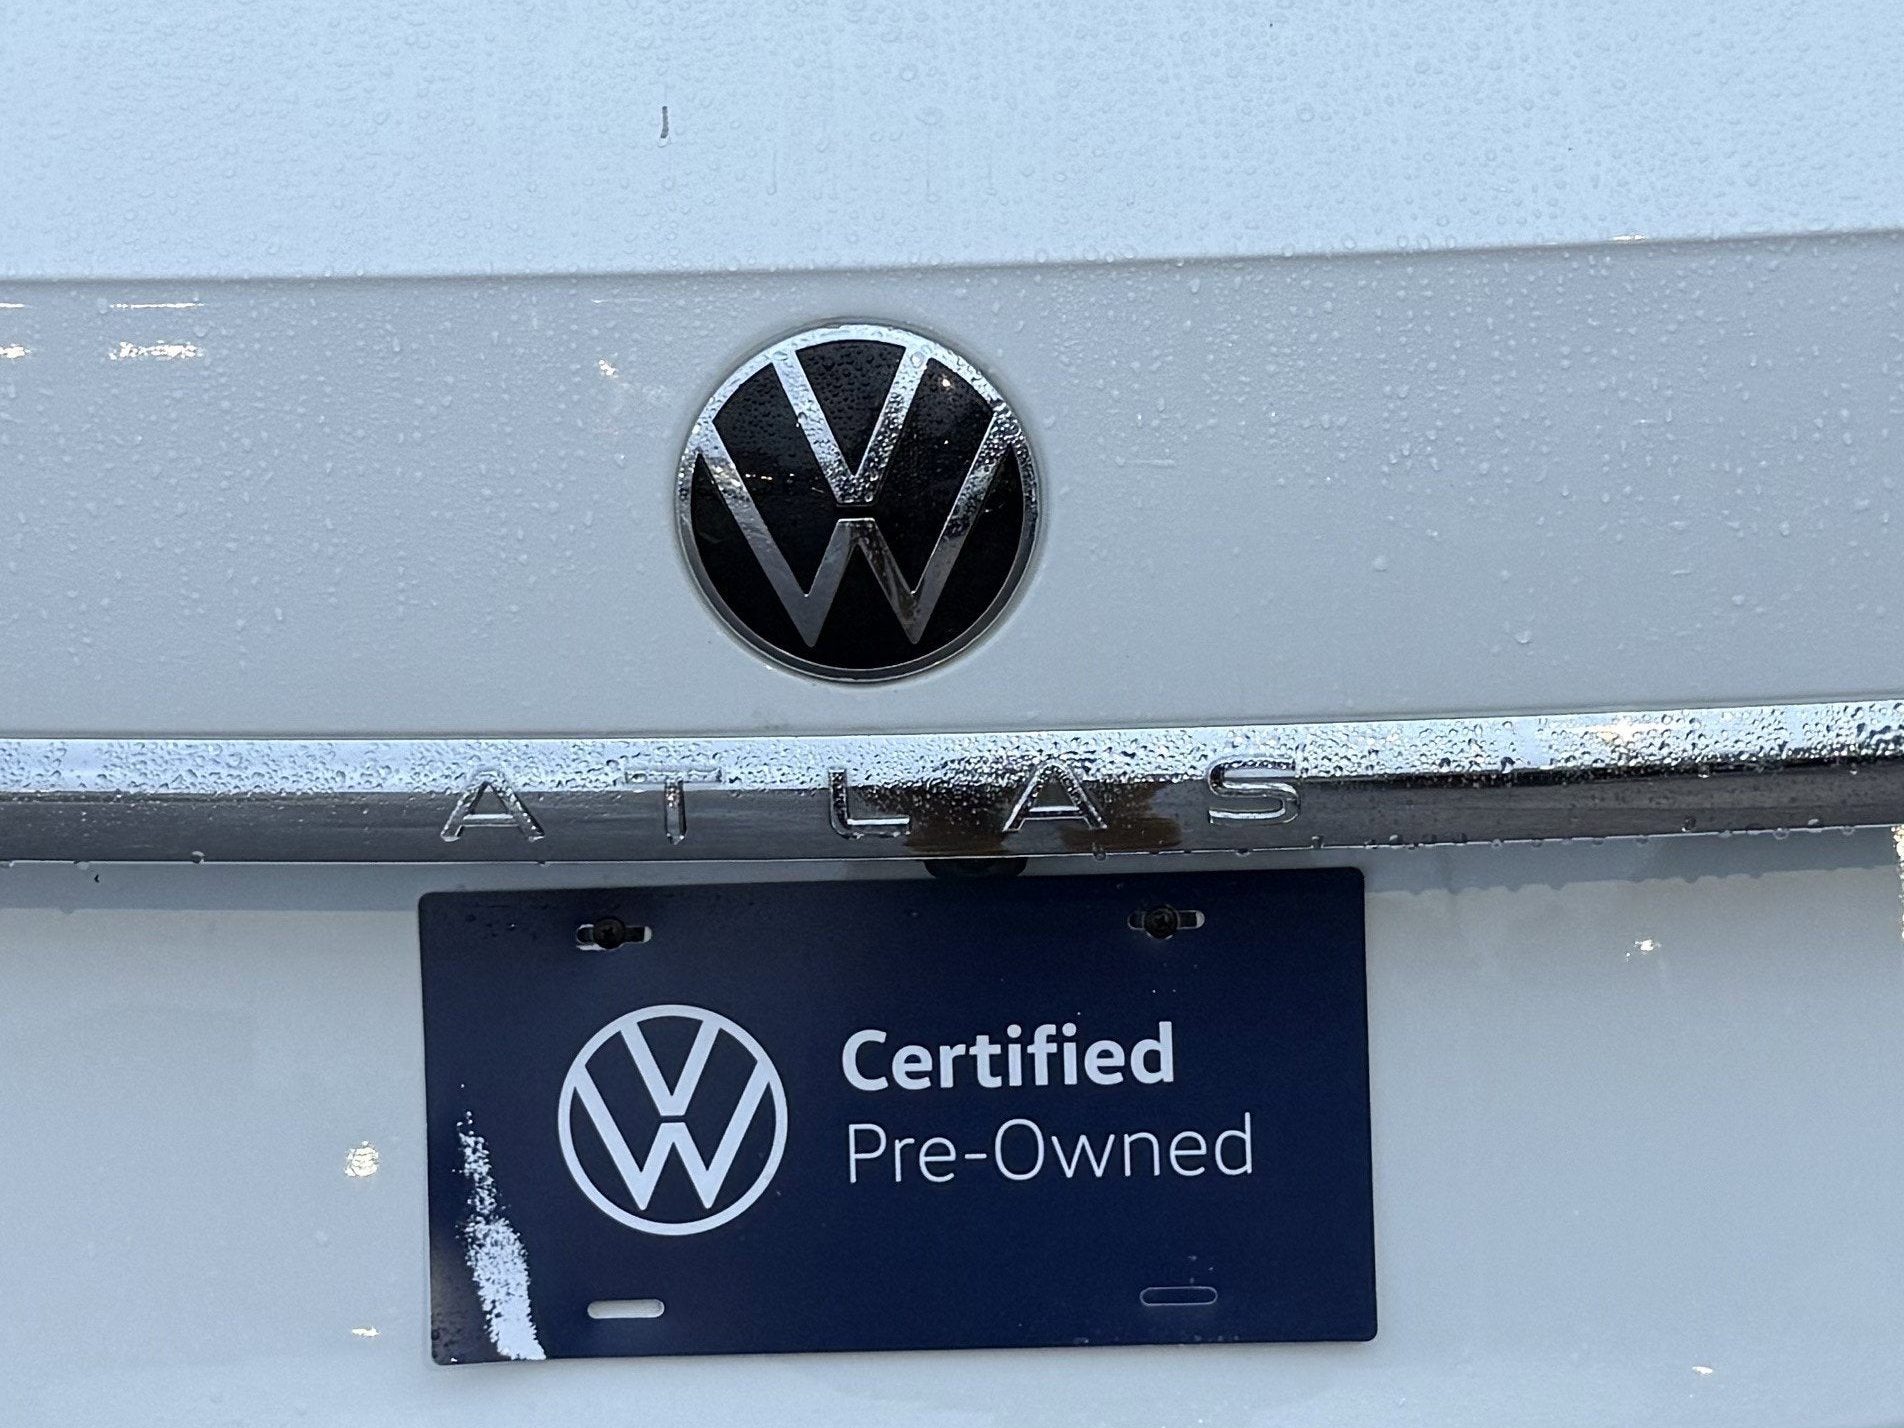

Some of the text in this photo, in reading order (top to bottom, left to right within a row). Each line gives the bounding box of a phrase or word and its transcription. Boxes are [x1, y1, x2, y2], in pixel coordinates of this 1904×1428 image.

[440, 756, 1301, 844] ATLAS
[842, 1021, 1174, 1091] Certified
[848, 1113, 1254, 1184] Pre-Owned
